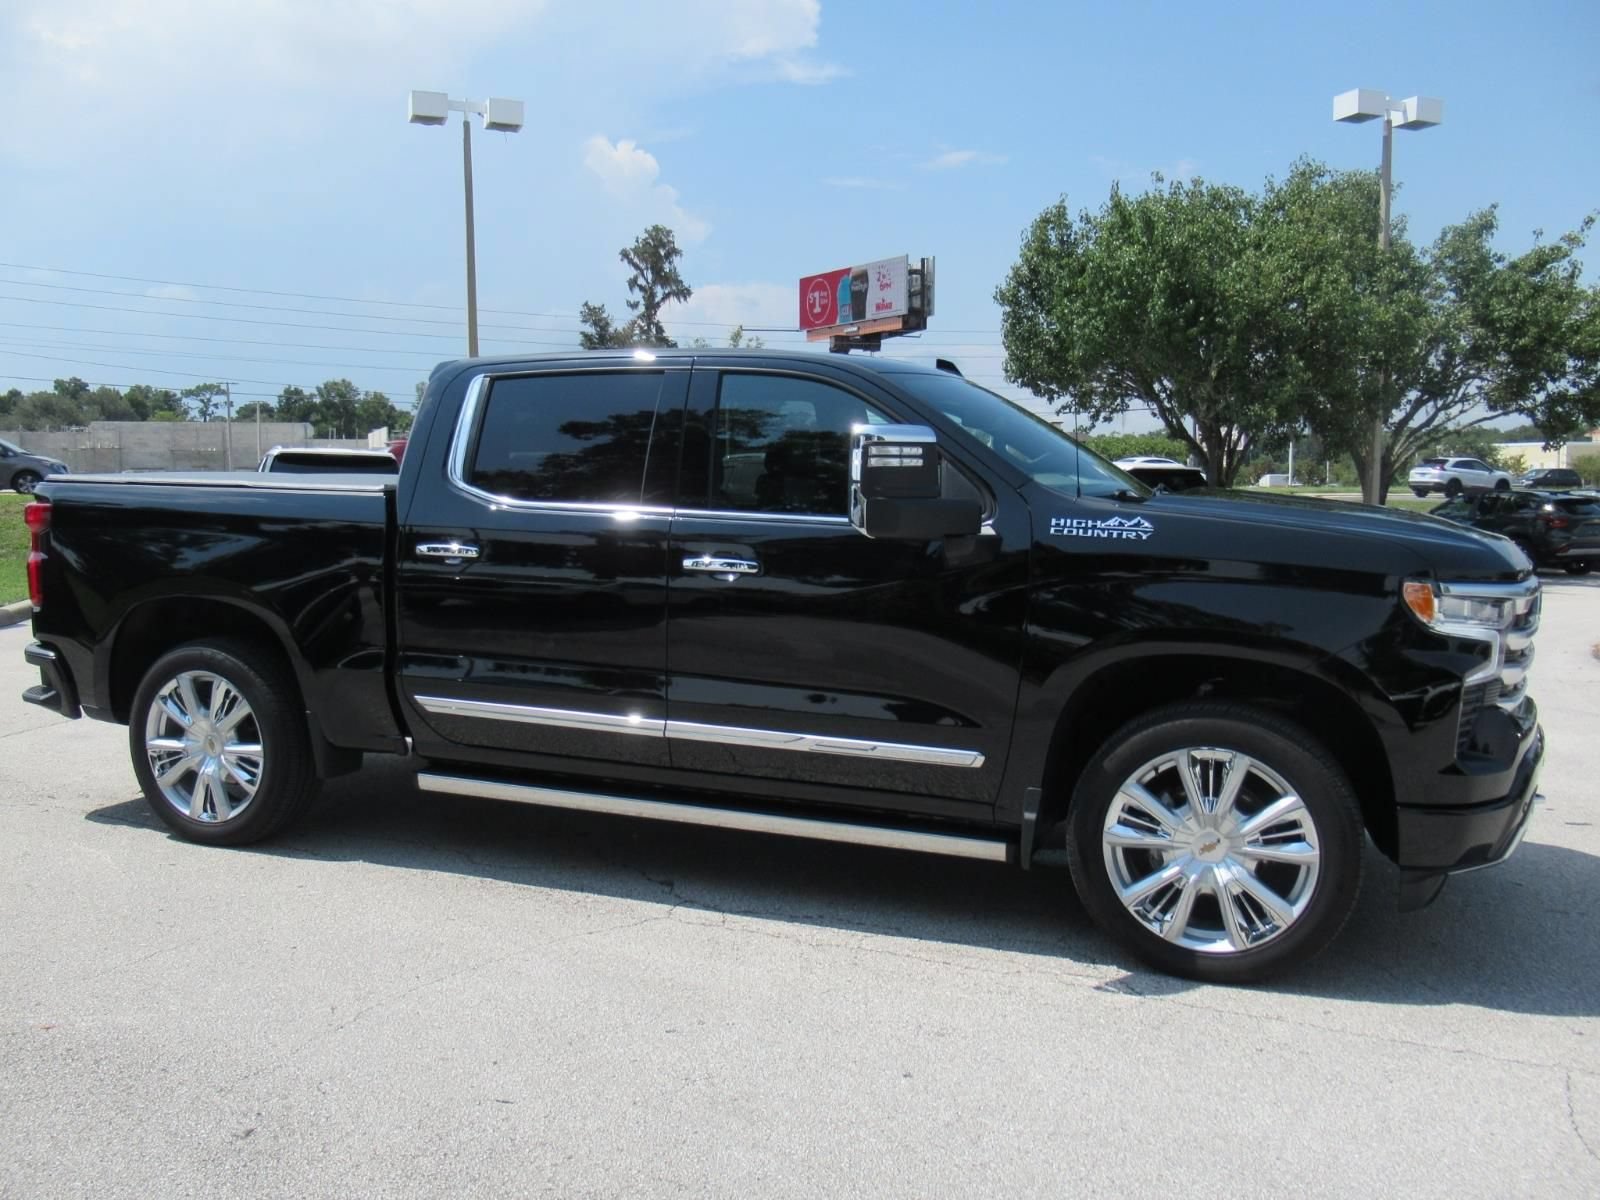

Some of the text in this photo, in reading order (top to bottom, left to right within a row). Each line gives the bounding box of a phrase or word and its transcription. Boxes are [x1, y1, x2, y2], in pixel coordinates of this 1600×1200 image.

[809, 291, 821, 313] $1
[1051, 517, 1102, 529] HIGH
[1050, 526, 1153, 541] COUNTRY
